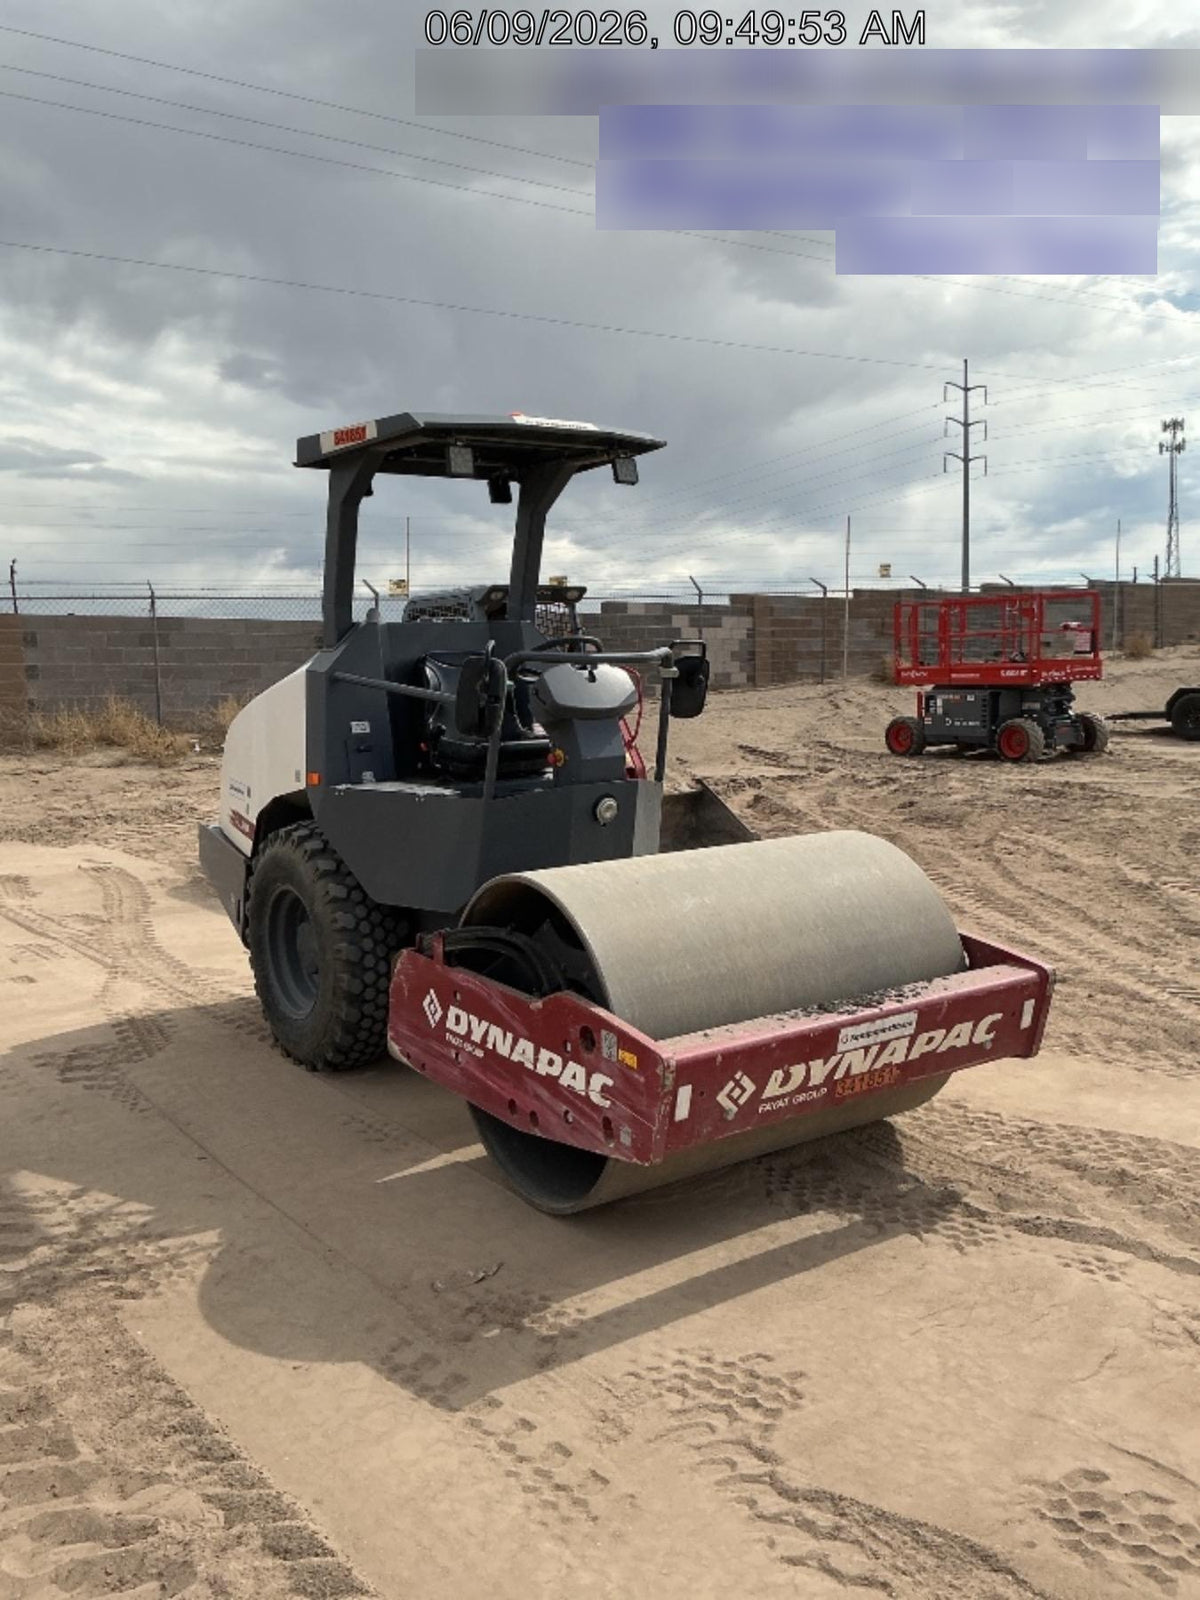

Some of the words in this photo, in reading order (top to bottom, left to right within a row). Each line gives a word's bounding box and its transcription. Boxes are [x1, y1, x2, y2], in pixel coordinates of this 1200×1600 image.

[445, 1006, 615, 1108] DYNAPAC
[761, 1013, 1003, 1097] DYNAPAC
[758, 1097, 790, 1114] FAYAT
